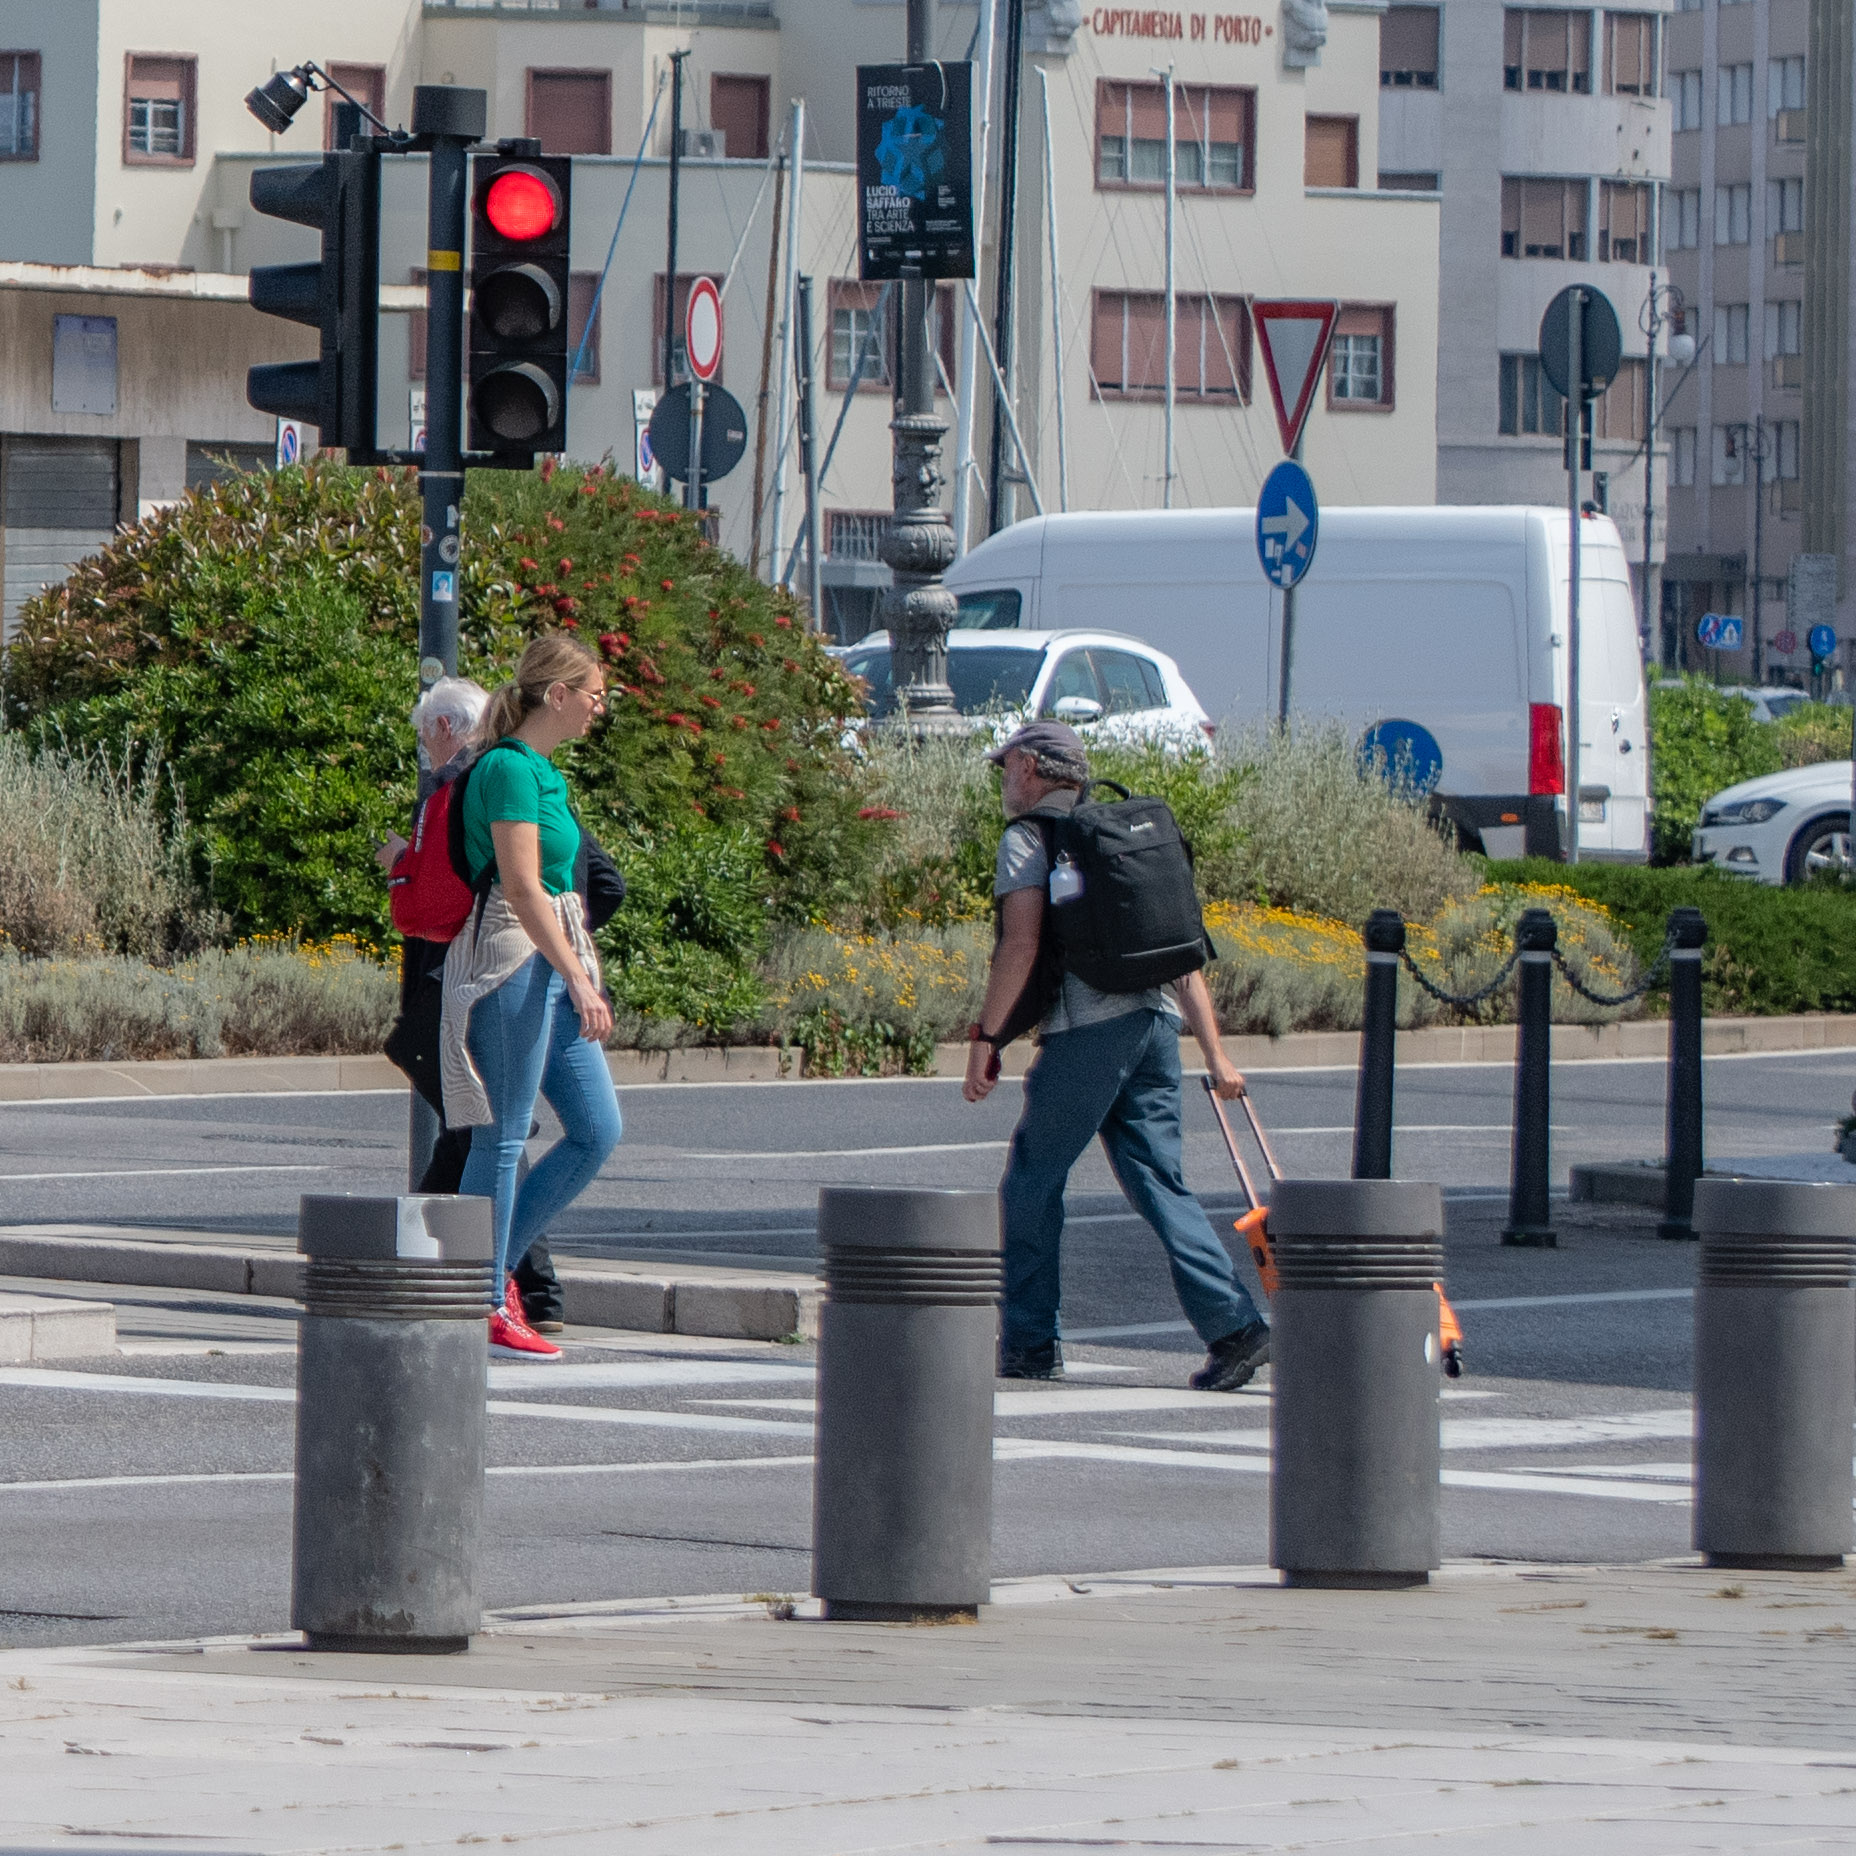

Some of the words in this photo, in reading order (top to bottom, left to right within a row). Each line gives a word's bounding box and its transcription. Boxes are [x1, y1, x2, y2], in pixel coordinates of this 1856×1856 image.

[1092, 7, 1183, 40] CAPITANERIA
[1190, 13, 1206, 40] DI
[1214, 14, 1262, 46] PORTO
[867, 85, 909, 97] RITORNO
[867, 98, 874, 109] A
[877, 96, 912, 110] TRIESTE
[866, 185, 896, 197] LUCIO
[867, 209, 885, 220] TRA
[886, 208, 910, 220] ARTE
[866, 221, 873, 233] E
[874, 220, 915, 232] SCIENZA
